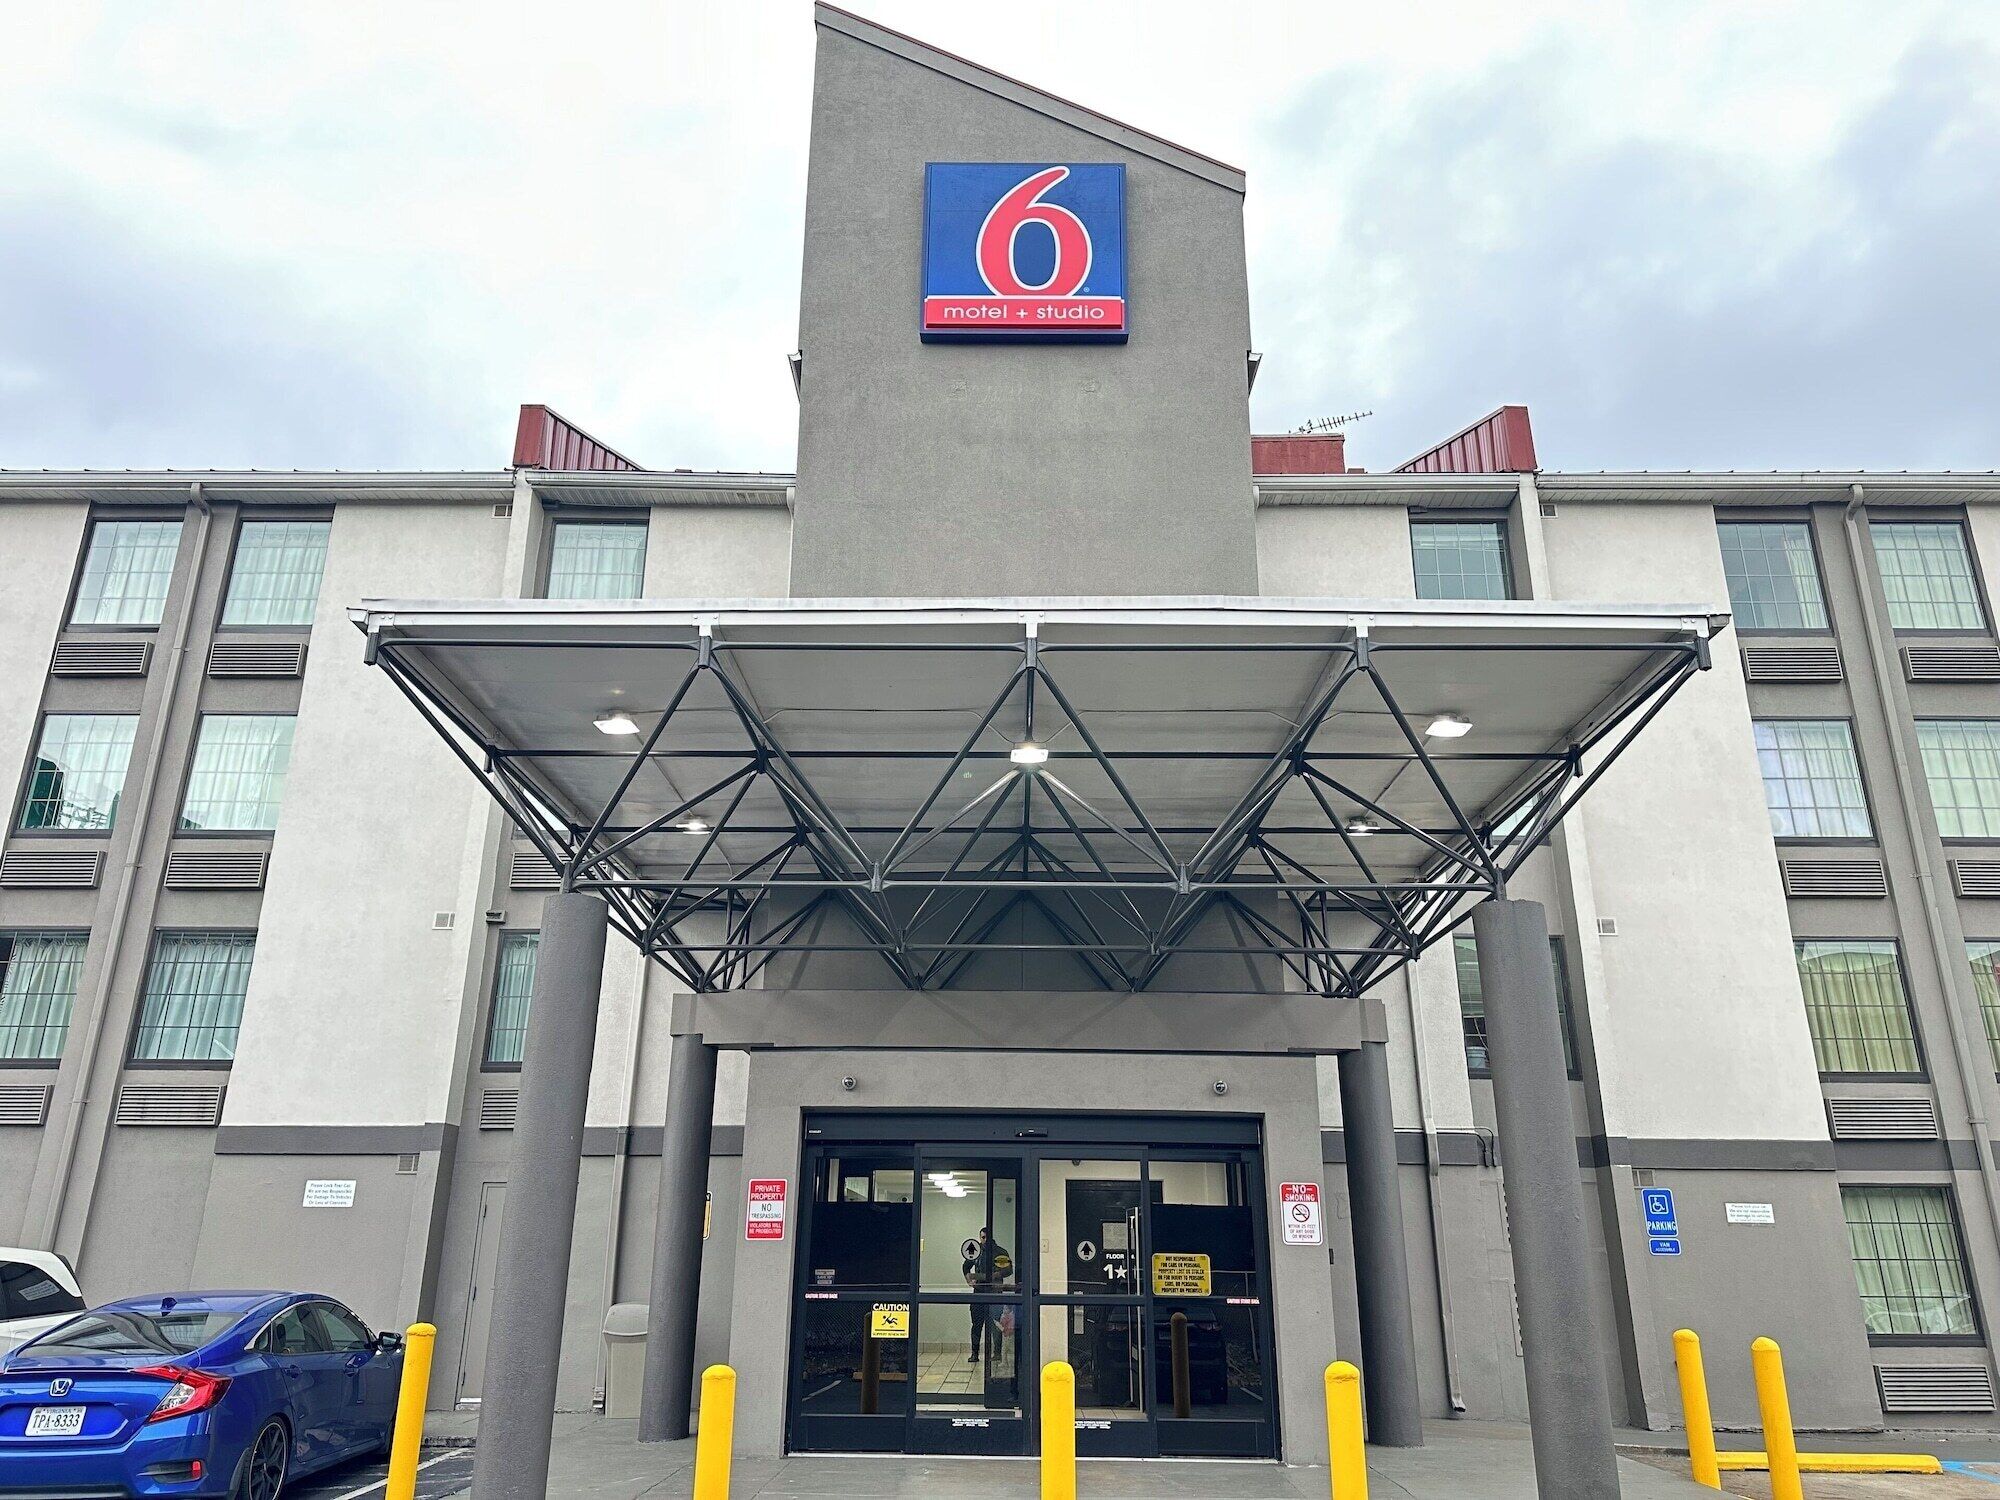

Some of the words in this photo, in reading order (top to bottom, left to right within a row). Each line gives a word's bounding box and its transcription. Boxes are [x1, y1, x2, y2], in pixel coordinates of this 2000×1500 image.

[975, 165, 1093, 298] 6
[943, 304, 1007, 319] motel
[1036, 304, 1105, 319] studio
[1292, 1184, 1306, 1194] NO
[751, 1192, 784, 1200] PROPERTY
[761, 1203, 772, 1211] NO
[1647, 1221, 1677, 1231] PARKING
[1103, 1264, 1113, 1279] 1
[872, 1303, 909, 1311] CAUTION
[32, 1413, 80, 1429] TPA-8333
